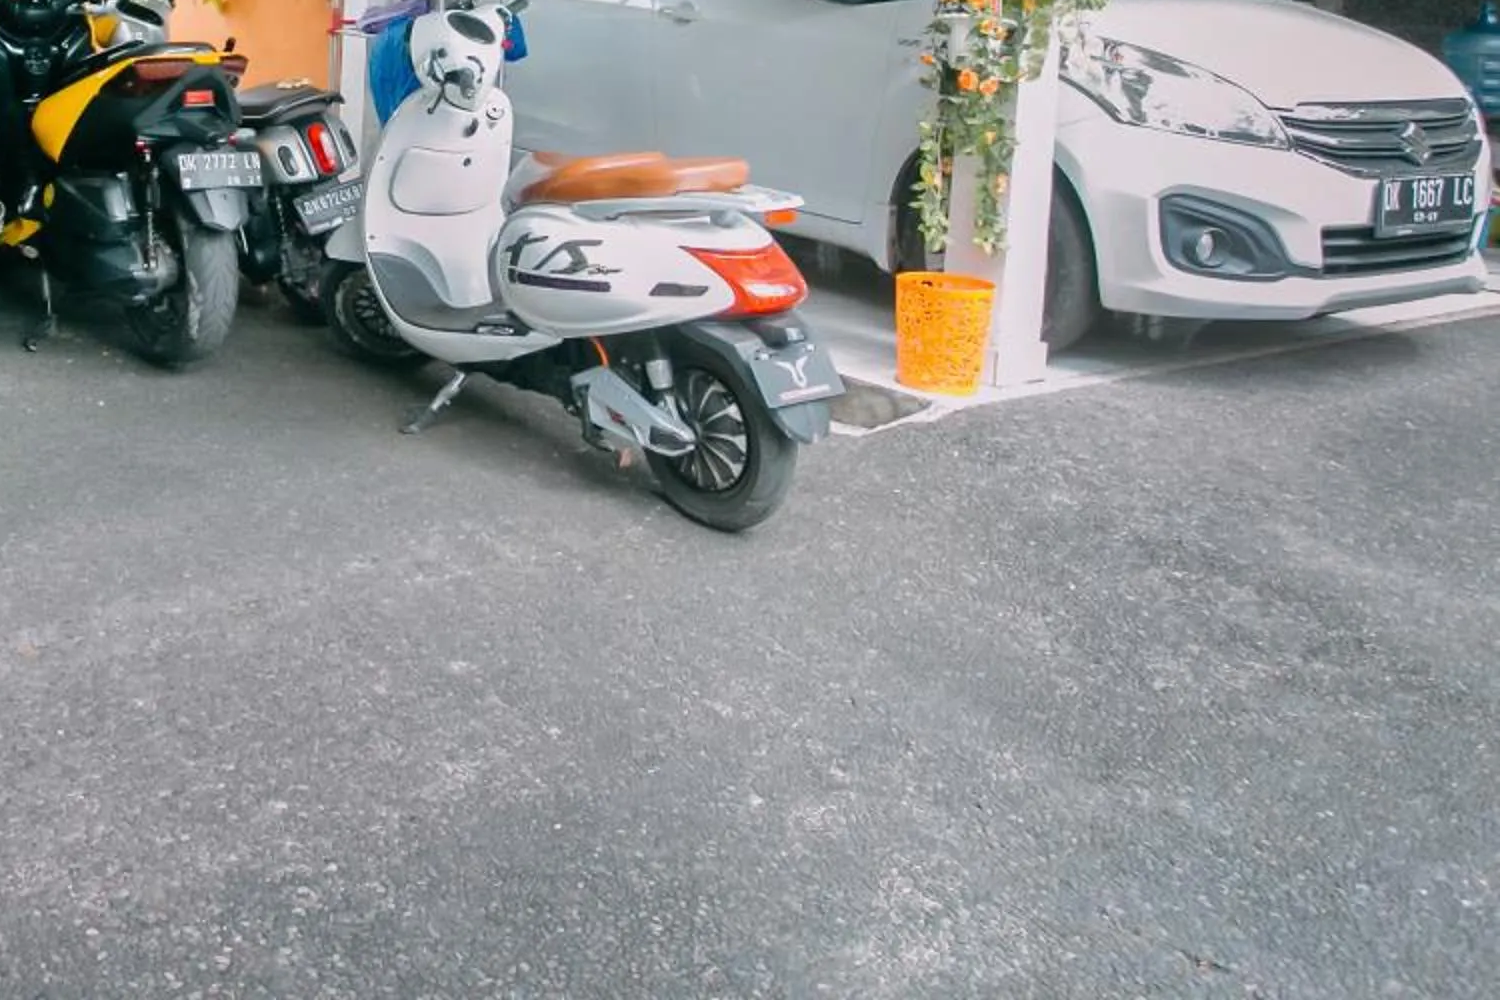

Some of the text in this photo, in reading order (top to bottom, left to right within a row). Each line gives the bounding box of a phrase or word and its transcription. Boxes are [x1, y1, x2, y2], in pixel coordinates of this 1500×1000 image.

[1383, 177, 1473, 211] DK 1667 LC
